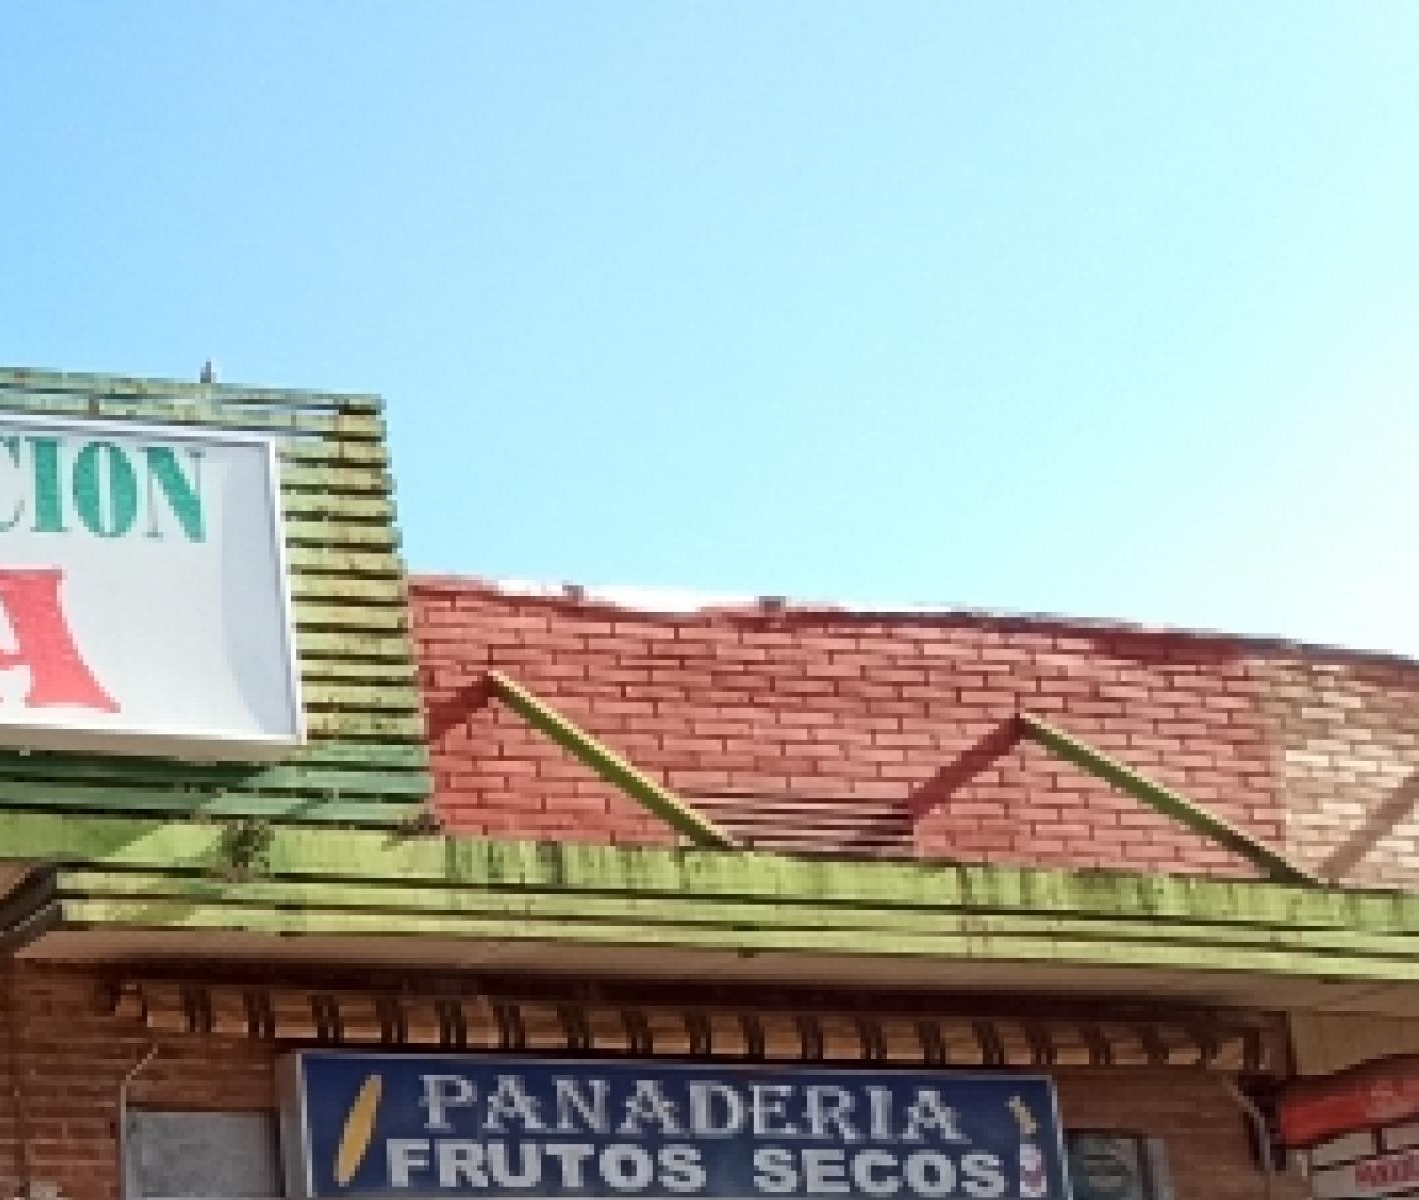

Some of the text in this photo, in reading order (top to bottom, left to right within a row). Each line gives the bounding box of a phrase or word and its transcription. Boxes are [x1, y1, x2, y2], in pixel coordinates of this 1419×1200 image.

[418, 1073, 968, 1144] PANADERIA
[386, 1138, 1006, 1199] FRUTOS SECOS
